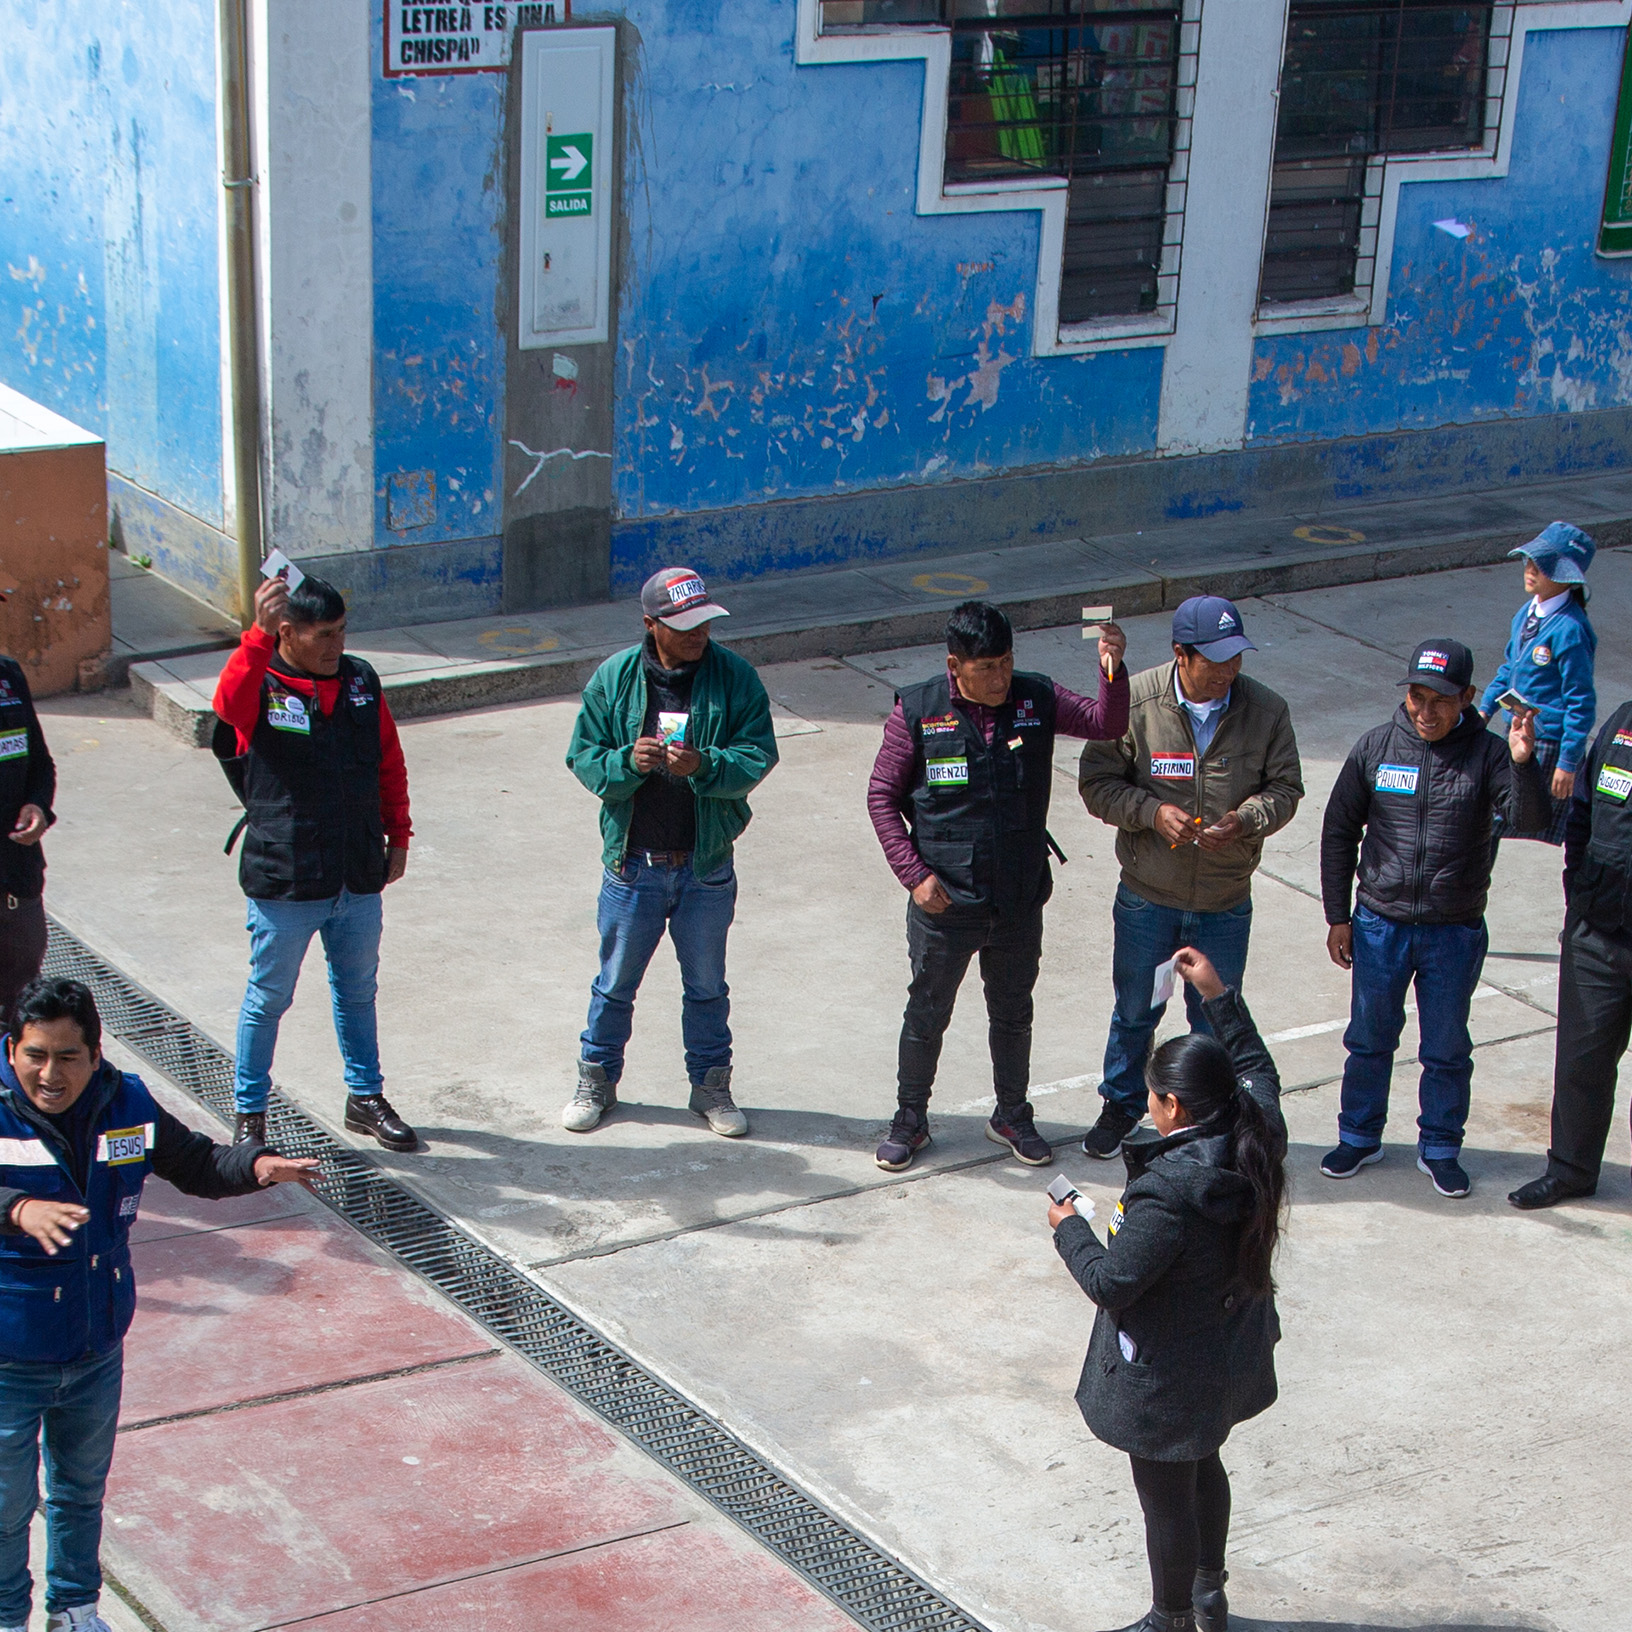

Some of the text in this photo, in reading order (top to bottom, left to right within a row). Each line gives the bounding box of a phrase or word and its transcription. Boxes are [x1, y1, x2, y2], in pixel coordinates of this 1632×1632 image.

[401, 8, 472, 34] LETREA
[484, 6, 506, 31] ES
[549, 198, 588, 213] SALIDA
[268, 709, 307, 725] TORIBIO
[1151, 759, 1192, 776] SEFIRINO
[1376, 769, 1415, 790] PAULINO
[1599, 771, 1631, 794] AUGUSTO
[108, 1136, 142, 1161] JESUS
